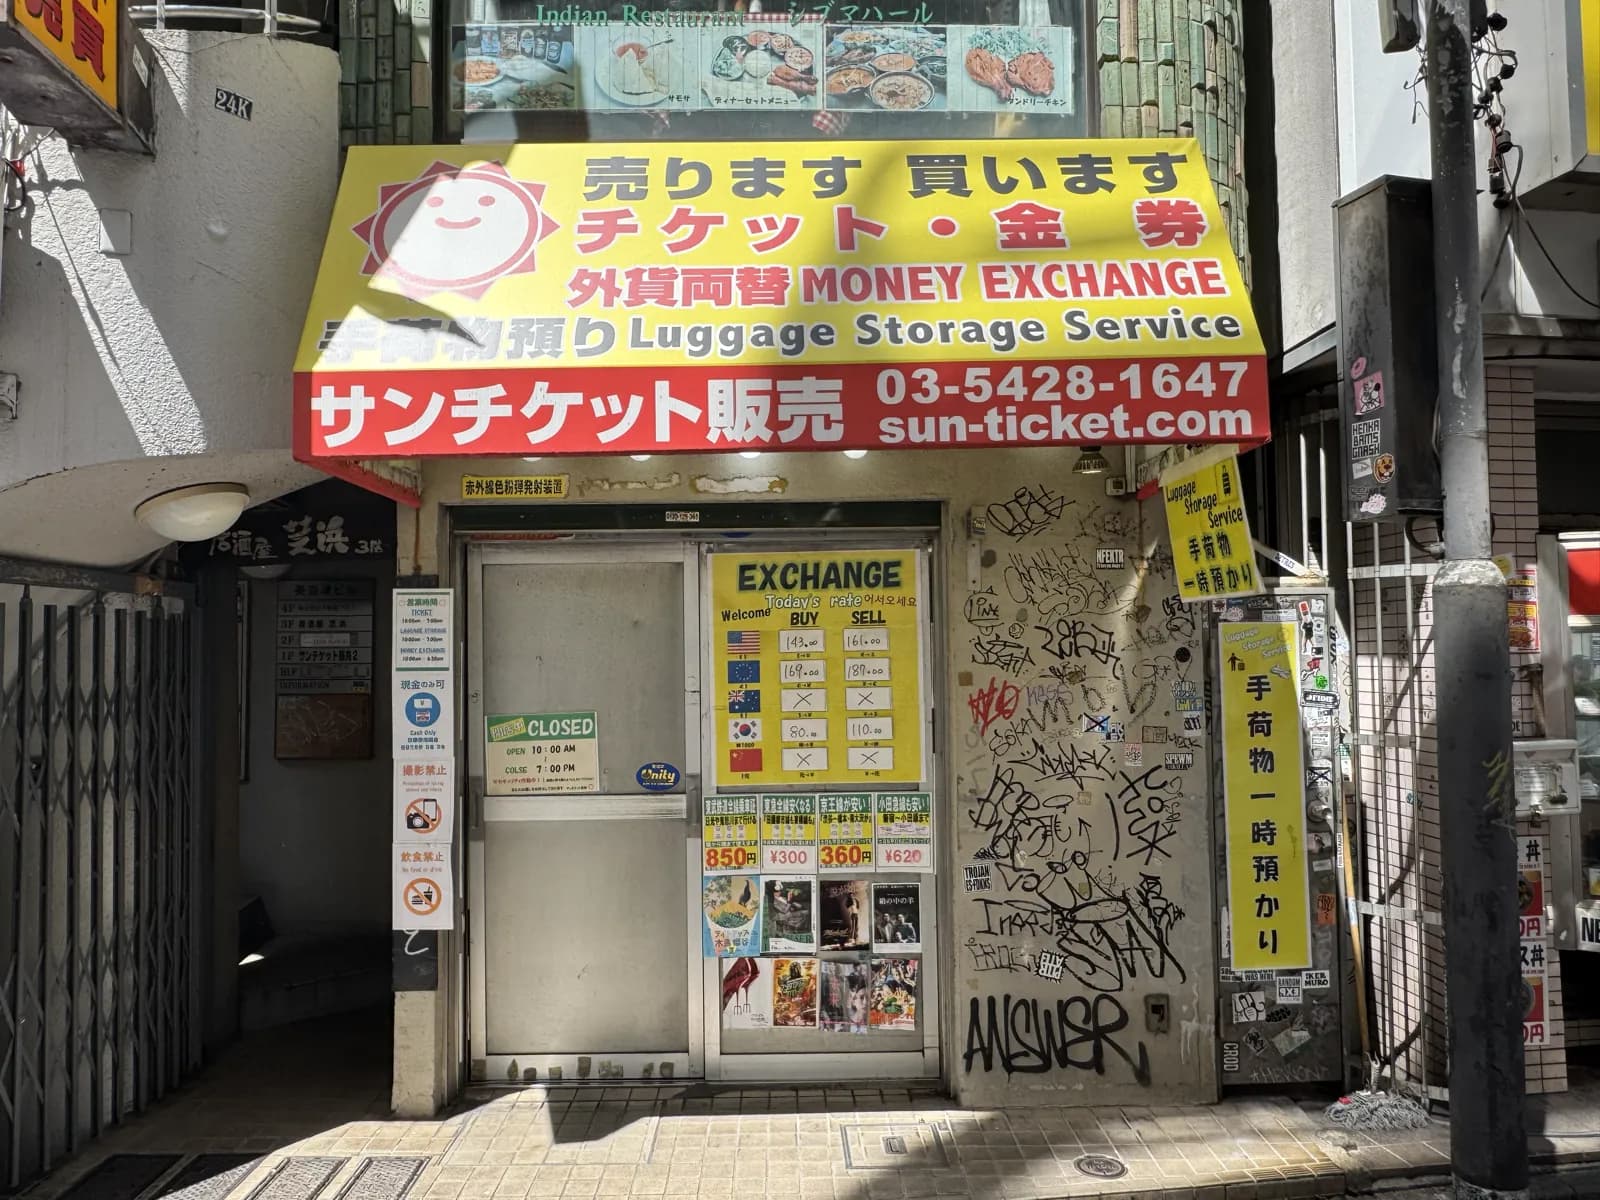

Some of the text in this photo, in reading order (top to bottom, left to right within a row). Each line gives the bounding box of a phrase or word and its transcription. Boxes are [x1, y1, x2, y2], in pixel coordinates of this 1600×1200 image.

[536, 4, 746, 27] Indian Restaurant
[217, 91, 251, 119] 24K
[668, 94, 691, 102] サモサ
[584, 151, 1190, 201] 売ります 買います
[567, 260, 1228, 309] 外貨両替 MONEY EXCHANGE
[318, 308, 1242, 363] 手荷物預り Luggage Storage Service
[877, 361, 1250, 405] 03-5428-1647
[311, 376, 845, 449] サンチケット販売
[878, 404, 1253, 444] sun-ticket.com
[1166, 480, 1197, 502] Luggage
[1184, 493, 1217, 515] Storage
[1208, 506, 1244, 529] Service
[1188, 531, 1232, 562] 手荷物
[738, 559, 903, 592] EXCHANGE
[1184, 563, 1253, 594] 一時預かり
[765, 592, 862, 610] Today's rate
[864, 594, 918, 608] 어서오세요
[721, 607, 772, 622] Welcome
[790, 611, 819, 626] BUY
[851, 610, 887, 625] SELL
[400, 679, 445, 690] 現金のみ可
[527, 718, 594, 737] CLOSED
[506, 747, 526, 756] OPEN
[563, 744, 576, 753] AM
[402, 764, 447, 776] 撮影禁止
[563, 764, 576, 772] PM
[1246, 675, 1281, 954] 手荷物一時預かり
[401, 851, 444, 863] 飲食禁止
[705, 847, 757, 867] 850円
[770, 850, 808, 864] ¥300
[820, 845, 872, 865] 360円
[884, 849, 922, 864] ¥620
[963, 993, 1152, 1086] ANSWER
